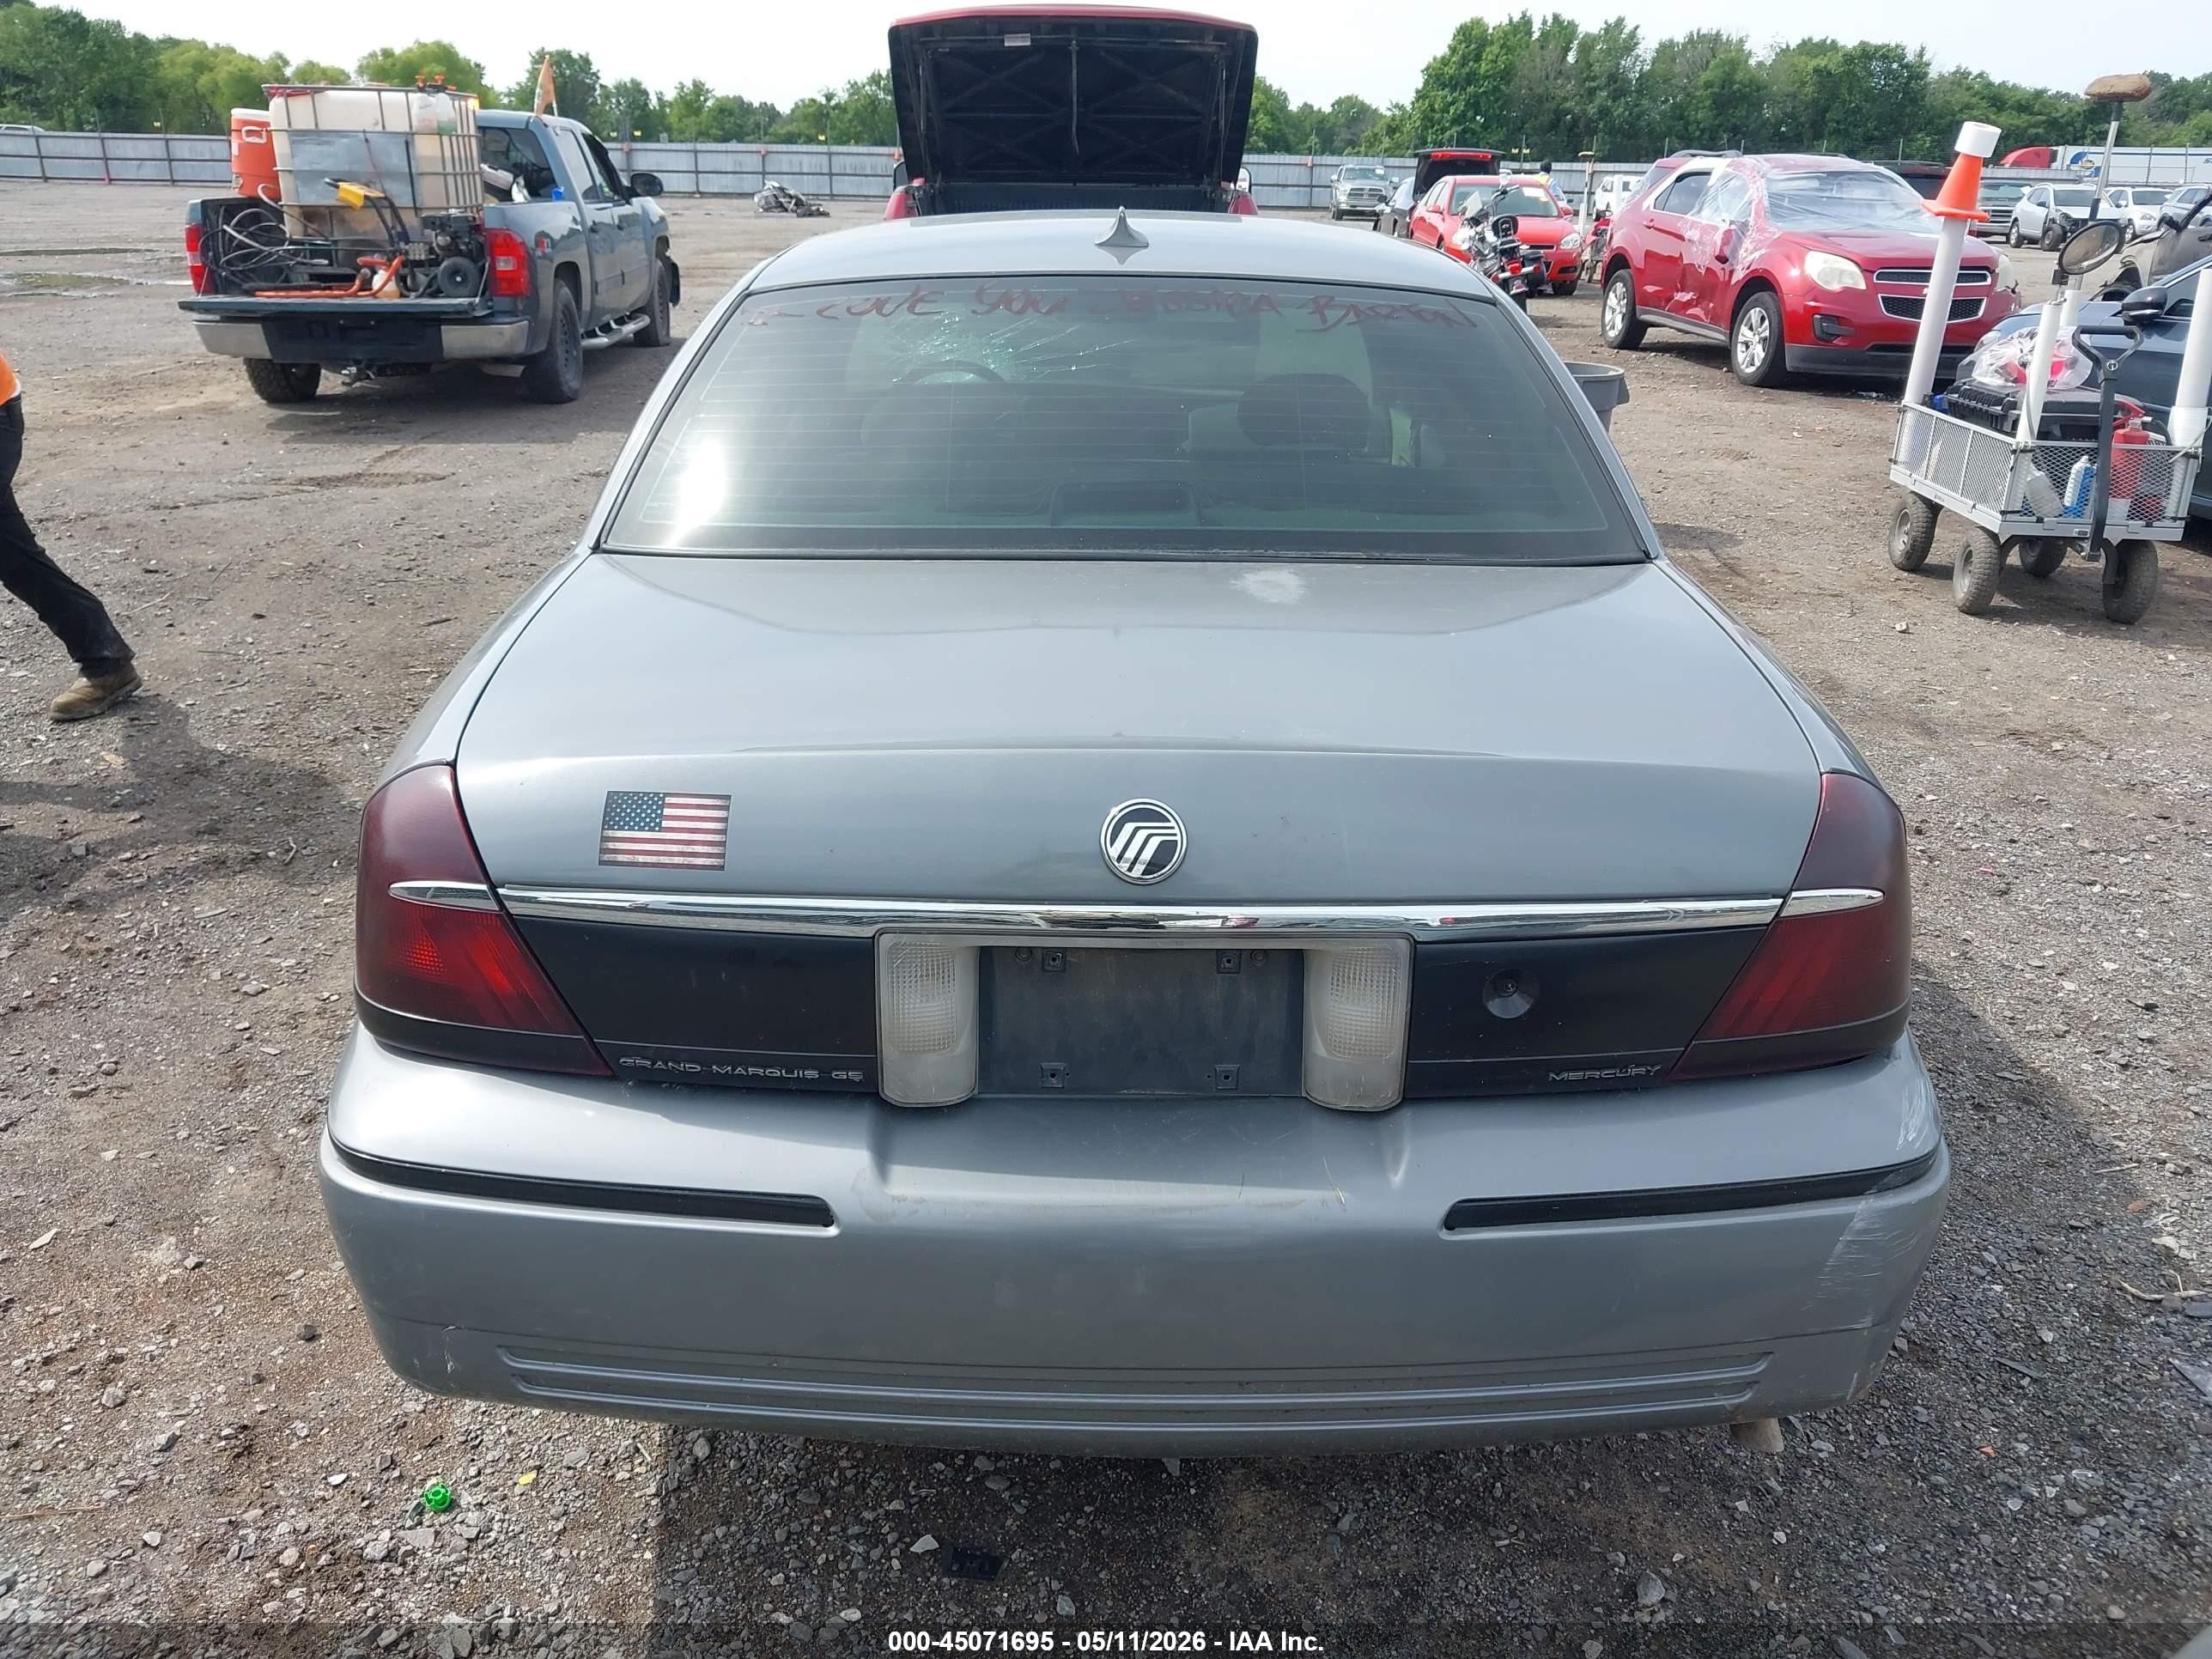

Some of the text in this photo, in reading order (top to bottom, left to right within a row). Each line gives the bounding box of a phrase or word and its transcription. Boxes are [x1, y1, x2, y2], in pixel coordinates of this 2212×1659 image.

[618, 1057, 864, 1080] GRAND MARQUIS GS
[1548, 1065, 1663, 1081] MERCURY
